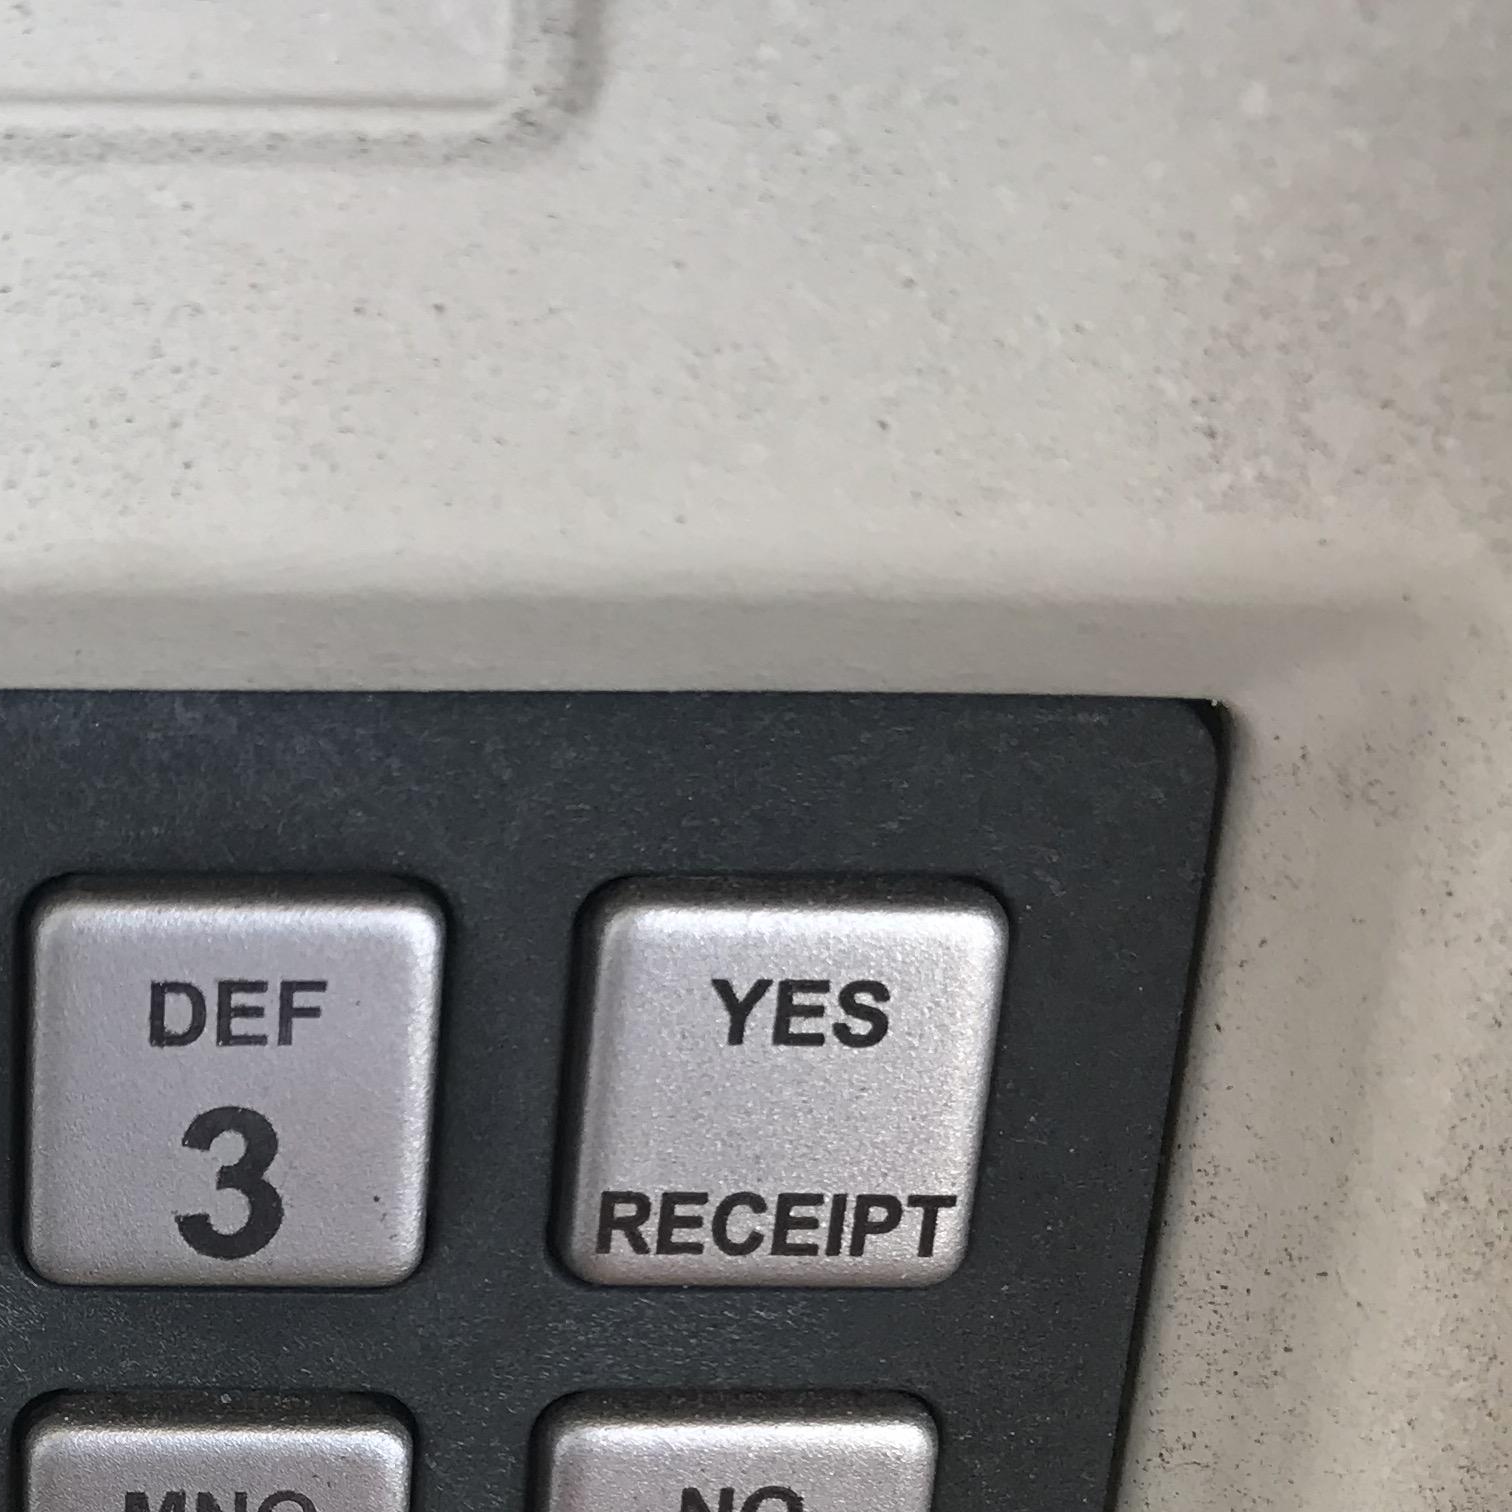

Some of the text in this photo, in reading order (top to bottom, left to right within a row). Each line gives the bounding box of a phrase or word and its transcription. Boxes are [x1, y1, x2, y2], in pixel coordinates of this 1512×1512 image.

[148, 979, 328, 1049] DEF
[710, 977, 891, 1049] YES
[174, 1106, 284, 1260] 3
[597, 1191, 958, 1259] RECEIPT
